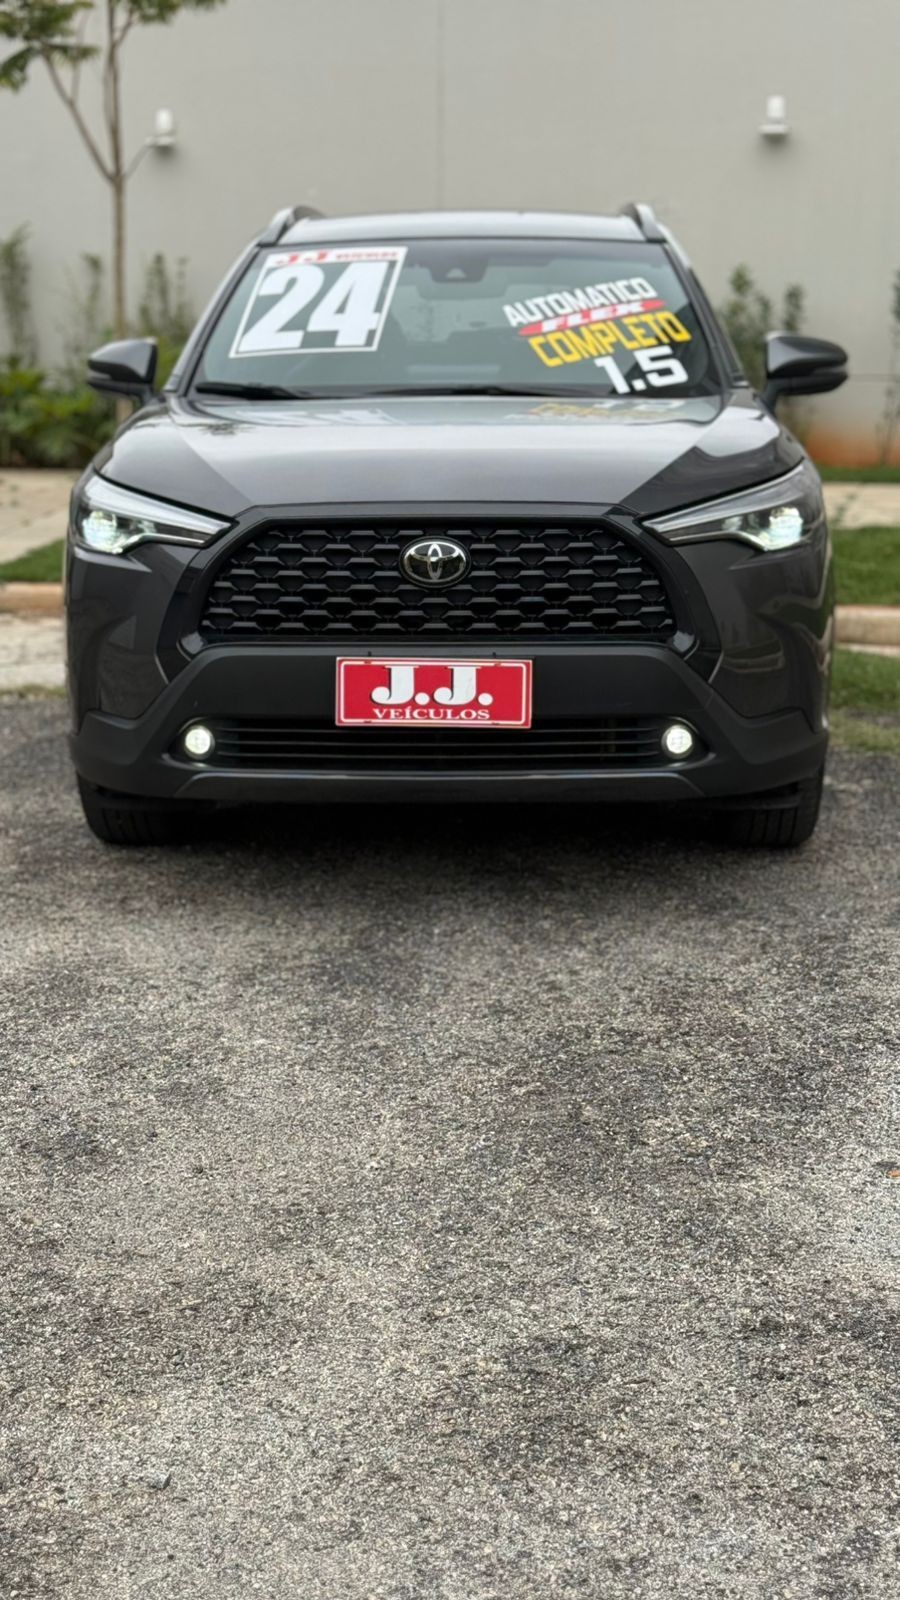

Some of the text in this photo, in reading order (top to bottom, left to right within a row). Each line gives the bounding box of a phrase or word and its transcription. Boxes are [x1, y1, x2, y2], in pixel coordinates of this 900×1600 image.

[238, 260, 381, 353] 24
[502, 277, 658, 328] AUTOMATICO
[541, 300, 643, 333] FLEX
[528, 311, 692, 368] COMPLETO
[594, 345, 689, 395] 1.5
[371, 665, 494, 706] J.J.
[372, 706, 490, 721] VEÍCULOS
